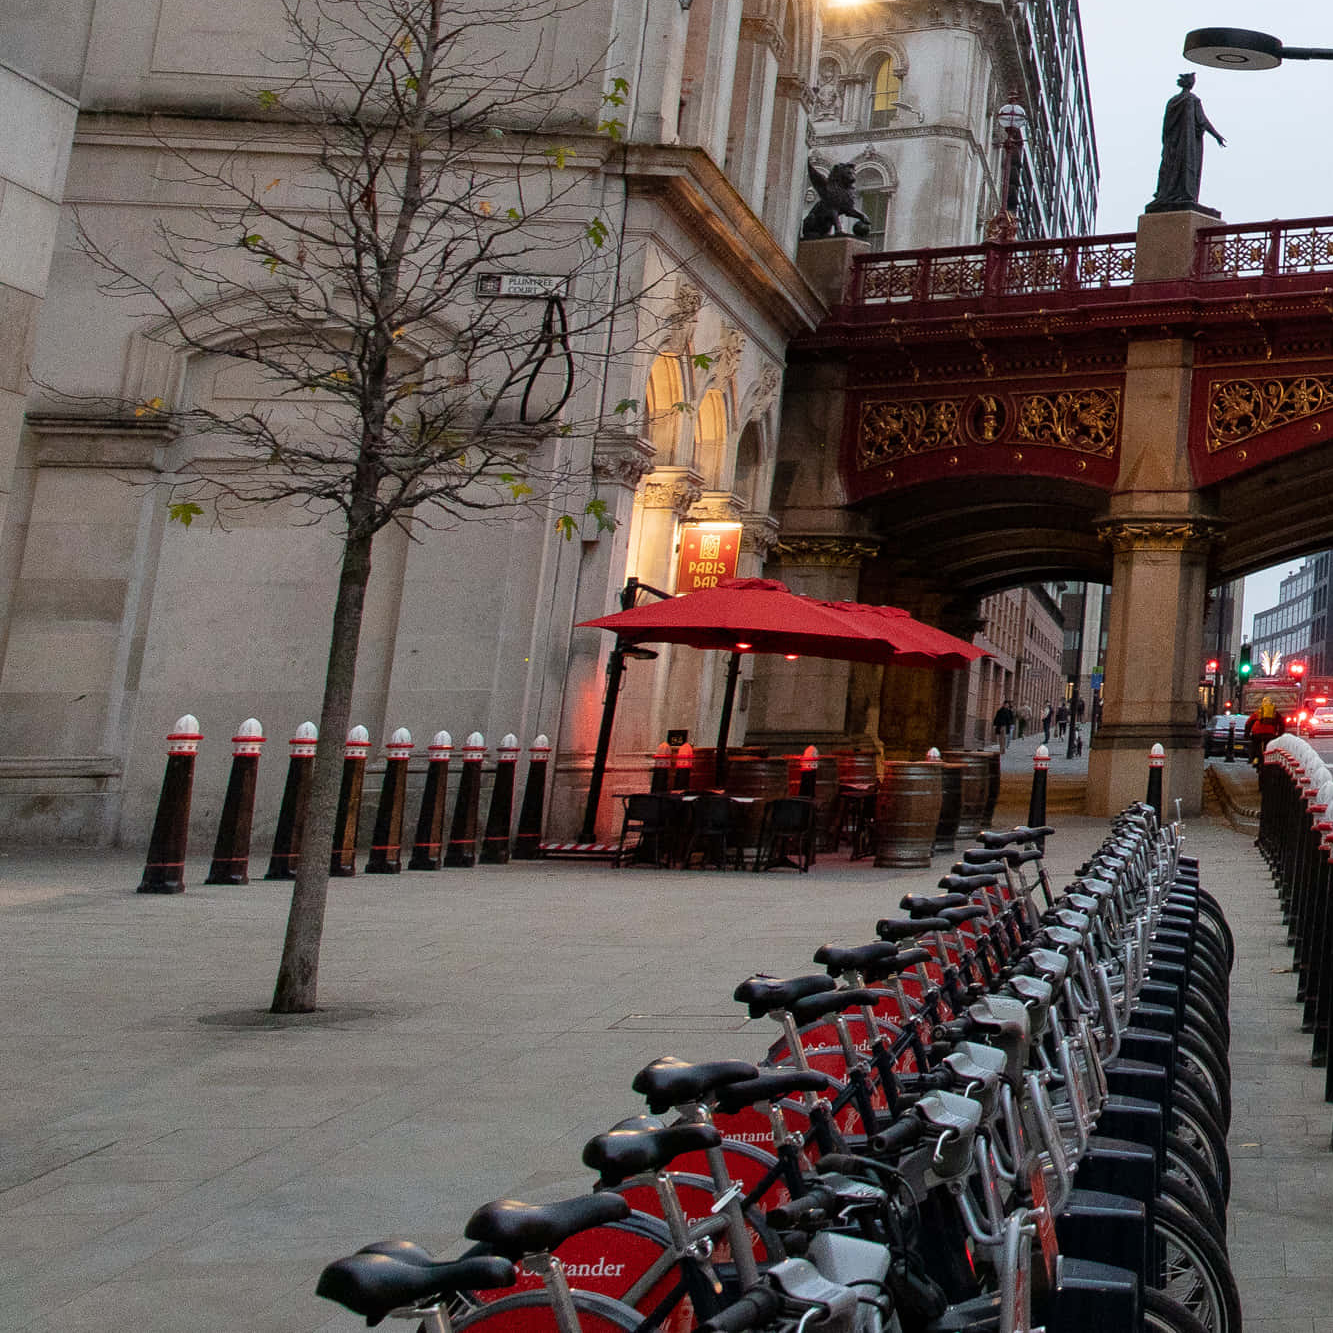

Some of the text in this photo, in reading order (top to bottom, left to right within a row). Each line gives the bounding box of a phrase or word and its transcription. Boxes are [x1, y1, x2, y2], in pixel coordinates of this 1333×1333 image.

[507, 286, 538, 295] COURT
[688, 561, 727, 575] PARIS
[693, 576, 719, 589] BAR
